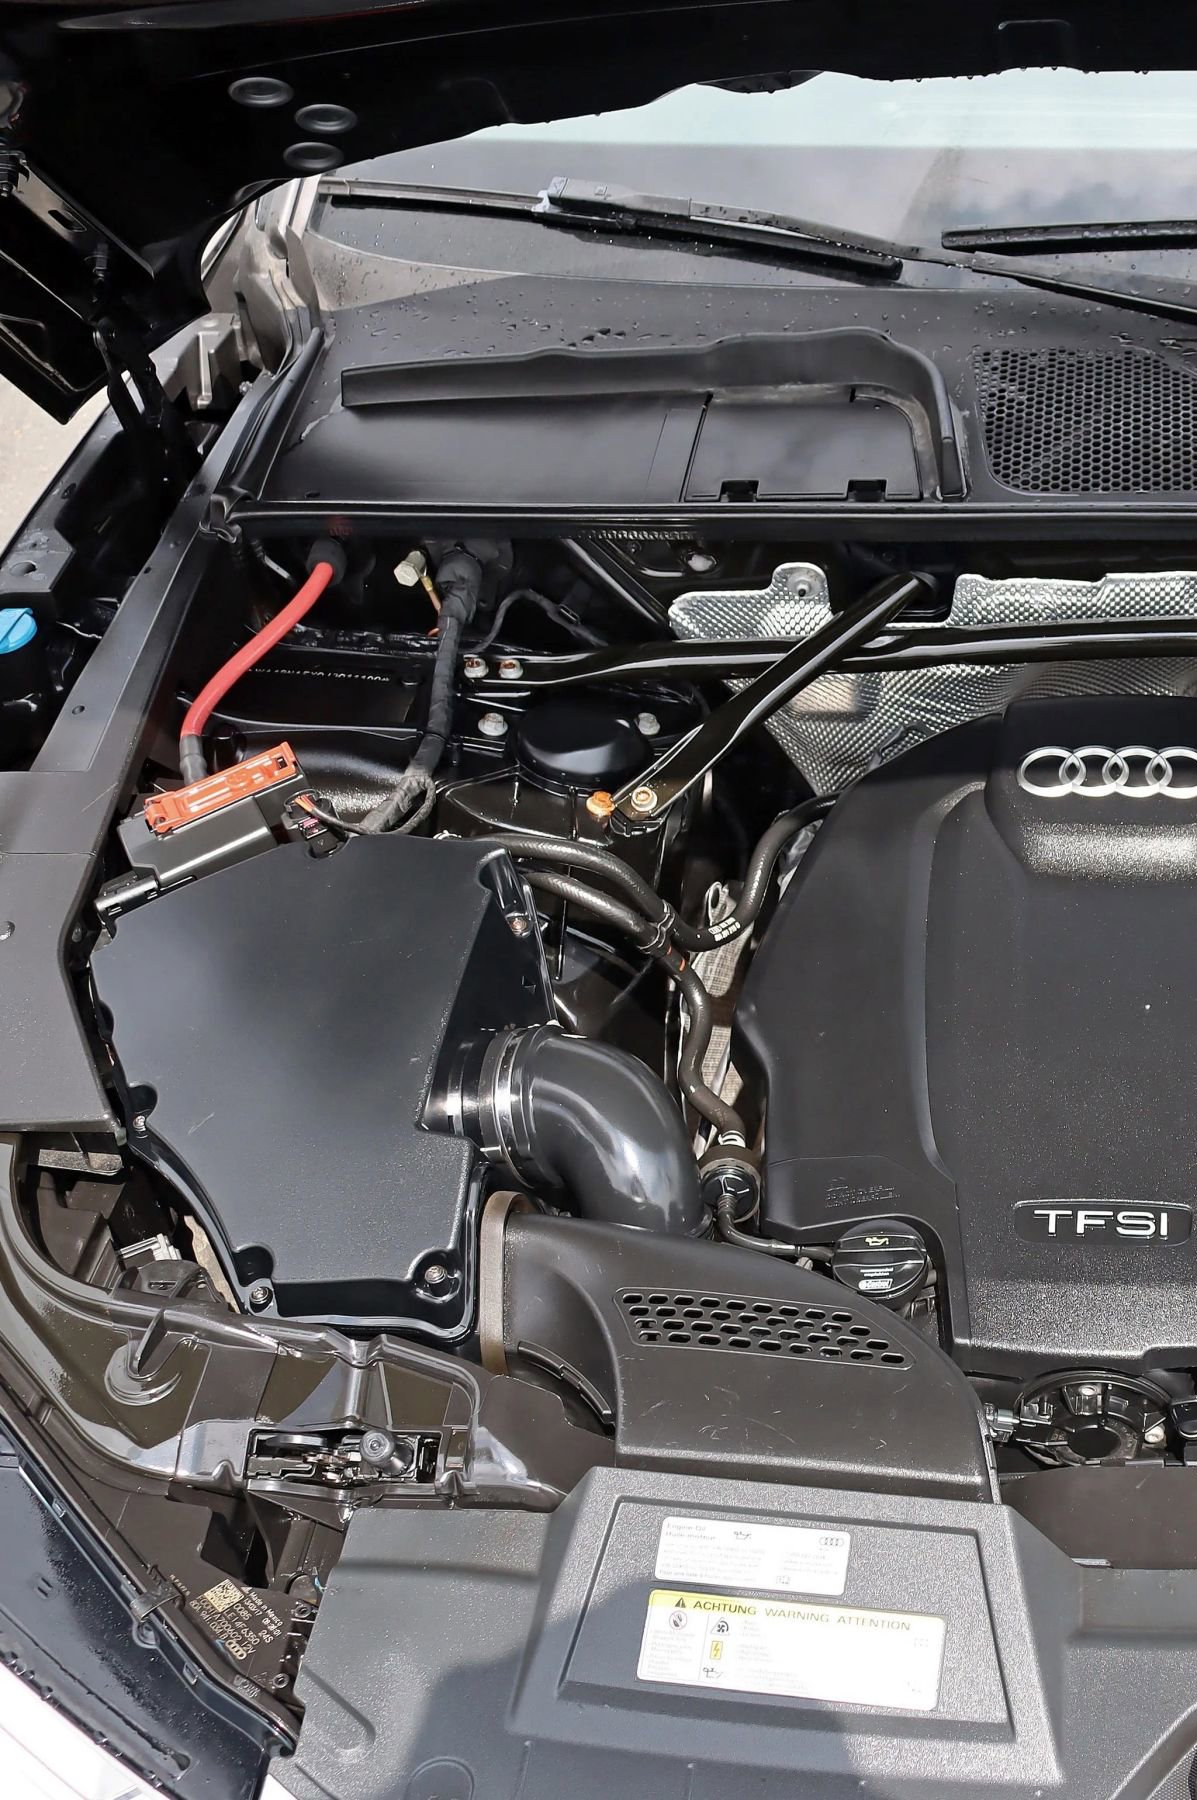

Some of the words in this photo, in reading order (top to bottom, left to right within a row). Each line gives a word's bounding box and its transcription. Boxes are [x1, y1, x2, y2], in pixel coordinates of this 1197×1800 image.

[1033, 1208, 1169, 1240] TFSI
[233, 1602, 253, 1621] 0085
[693, 1599, 757, 1616] ACHTUNG
[764, 1607, 829, 1624] WARNING
[836, 1614, 911, 1632] ATTENTION
